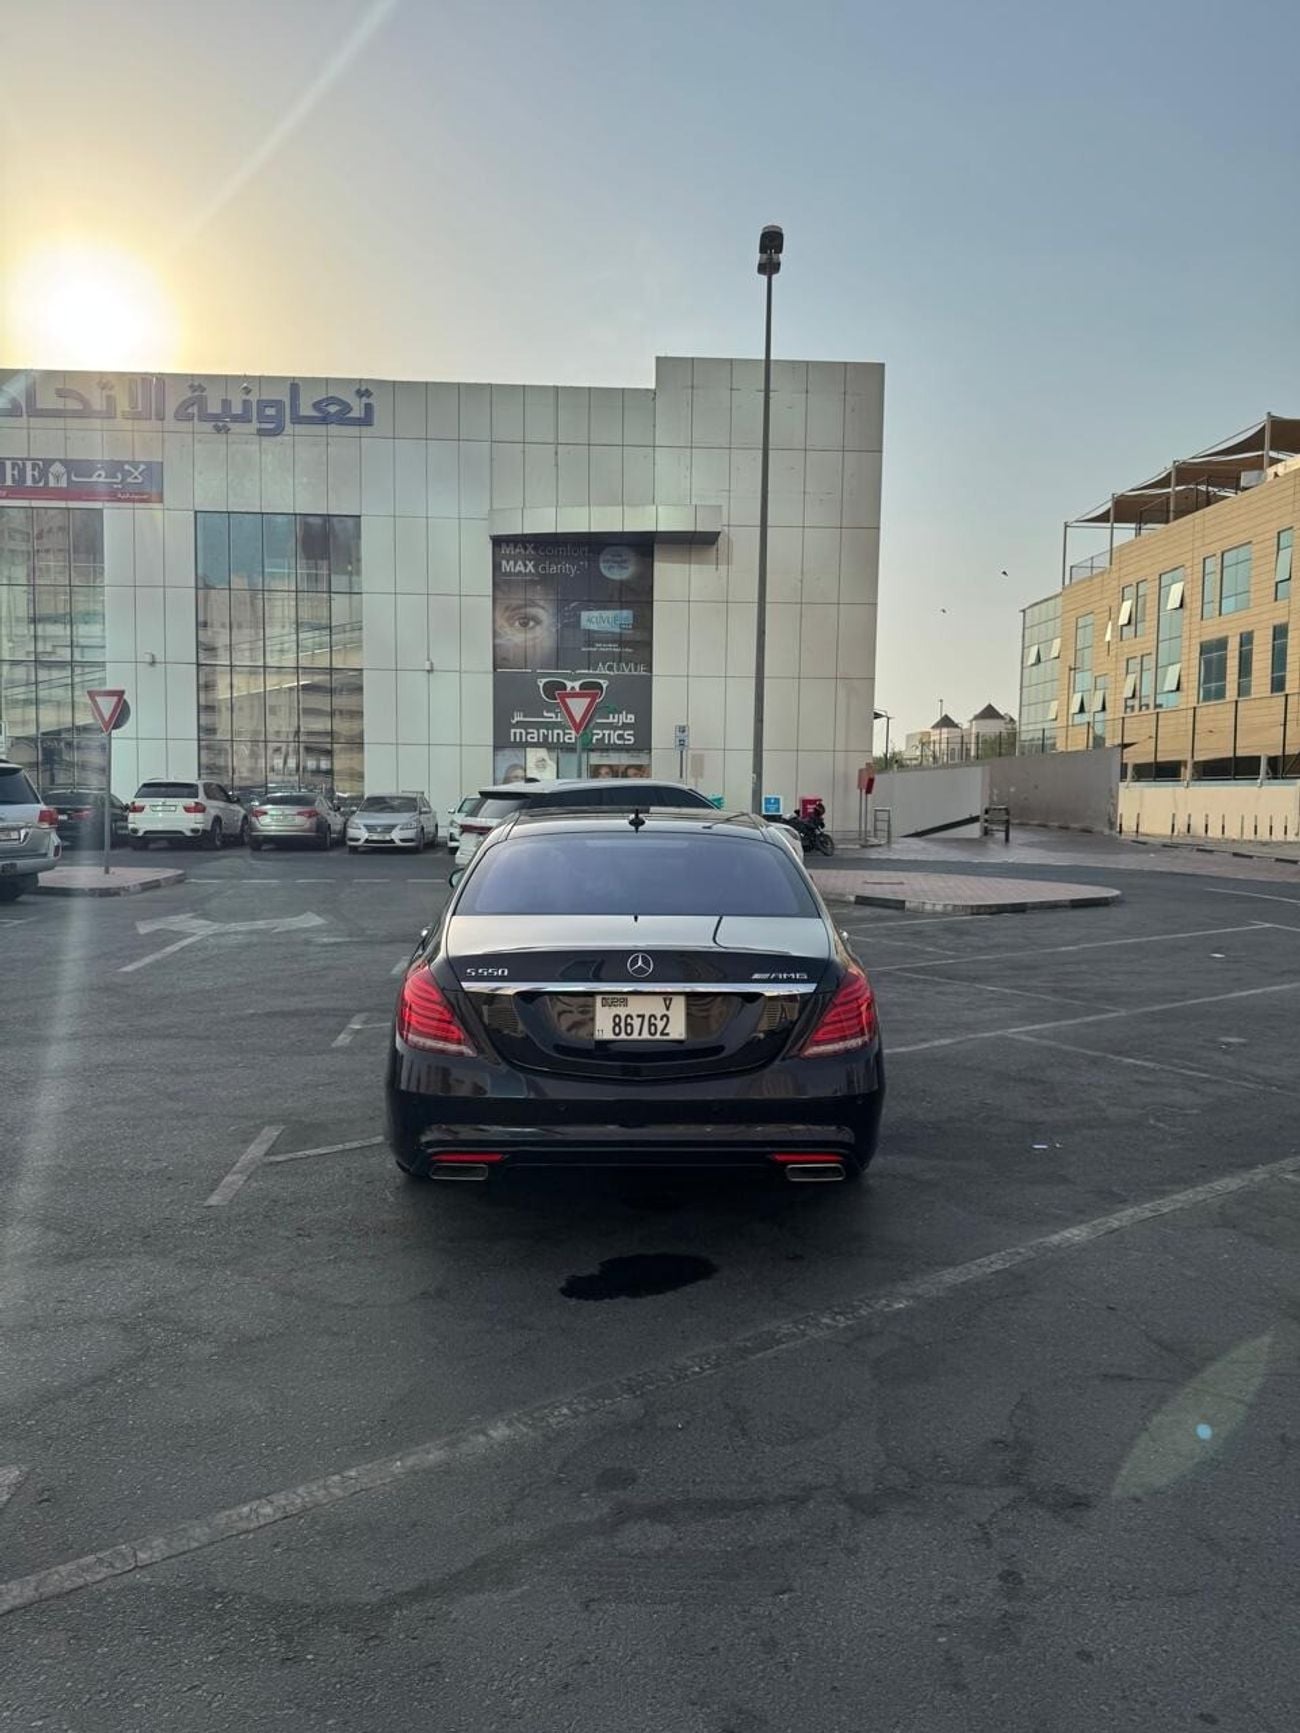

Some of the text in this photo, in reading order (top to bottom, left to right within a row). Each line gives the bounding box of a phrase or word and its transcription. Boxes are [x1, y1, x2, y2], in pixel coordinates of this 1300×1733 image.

[174, 380, 374, 437] تعاونية
[0, 459, 46, 487] FE
[71, 464, 147, 489] لايف
[500, 542, 535, 555] MAX
[501, 560, 536, 573] MAX
[510, 728, 576, 743] marina
[662, 996, 673, 1011] V
[612, 1013, 670, 1037] 86762
